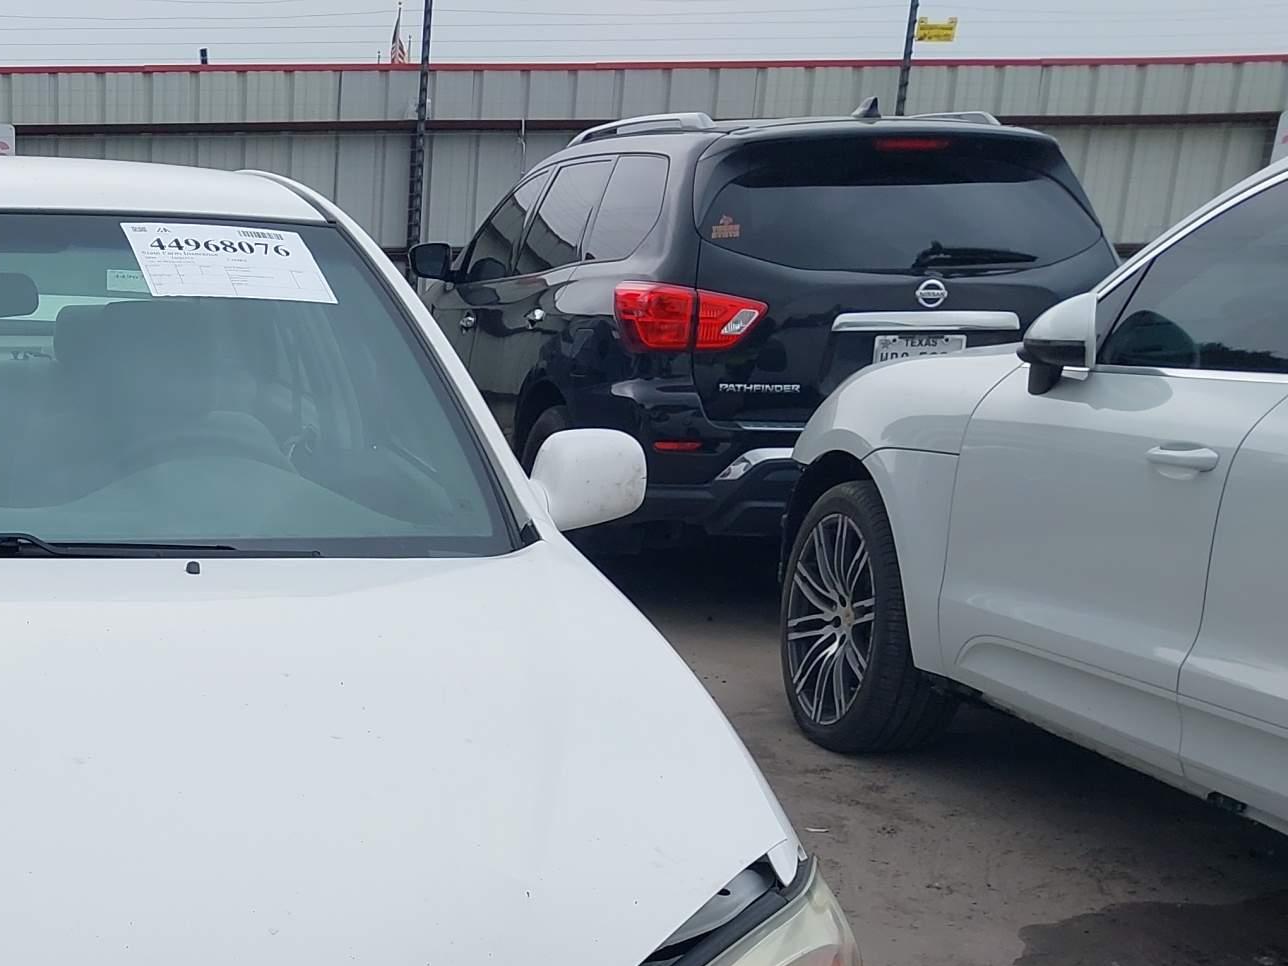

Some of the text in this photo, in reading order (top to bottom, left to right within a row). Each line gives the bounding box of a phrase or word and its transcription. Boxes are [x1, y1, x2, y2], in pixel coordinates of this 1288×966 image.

[150, 237, 291, 257] 44968076
[904, 339, 938, 348] TEXAS
[719, 383, 801, 393] PATHFINDER
